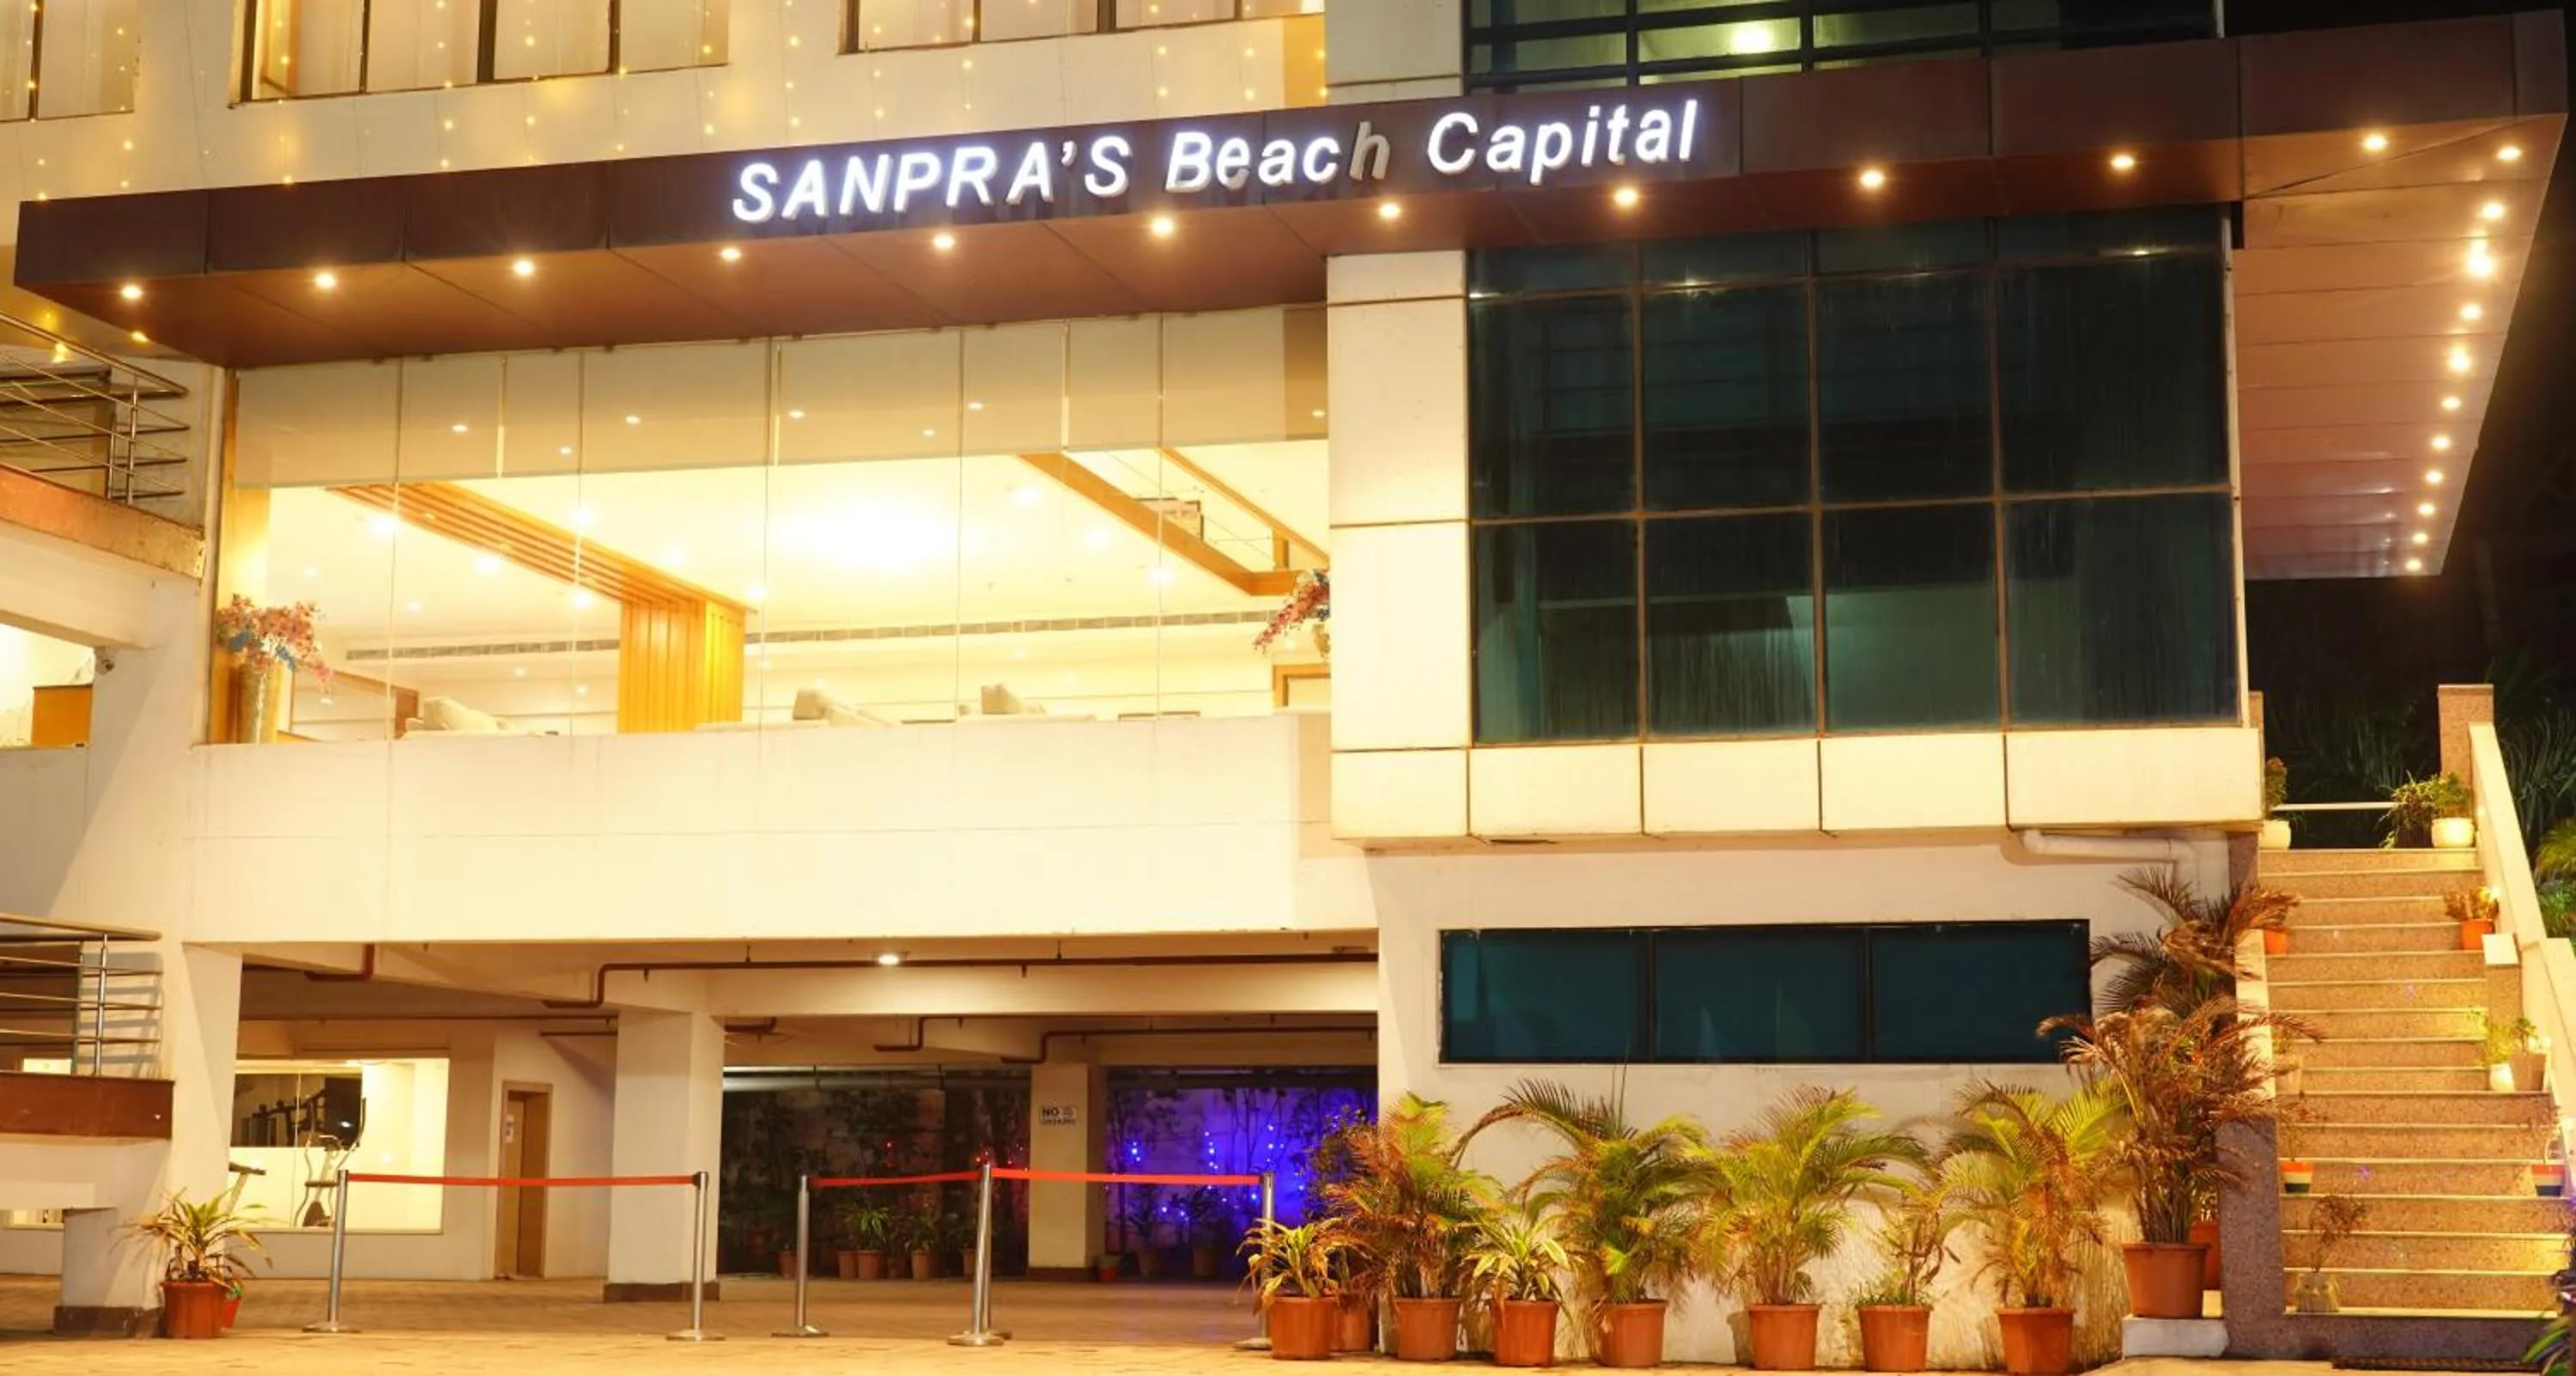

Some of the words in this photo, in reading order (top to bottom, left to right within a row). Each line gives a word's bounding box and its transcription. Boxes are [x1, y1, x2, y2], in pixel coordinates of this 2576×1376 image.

[732, 135, 1133, 222] SANPRA'S
[1164, 120, 1391, 193] Beach
[1426, 99, 1698, 186] Capital
[1042, 1106, 1060, 1117] NO
